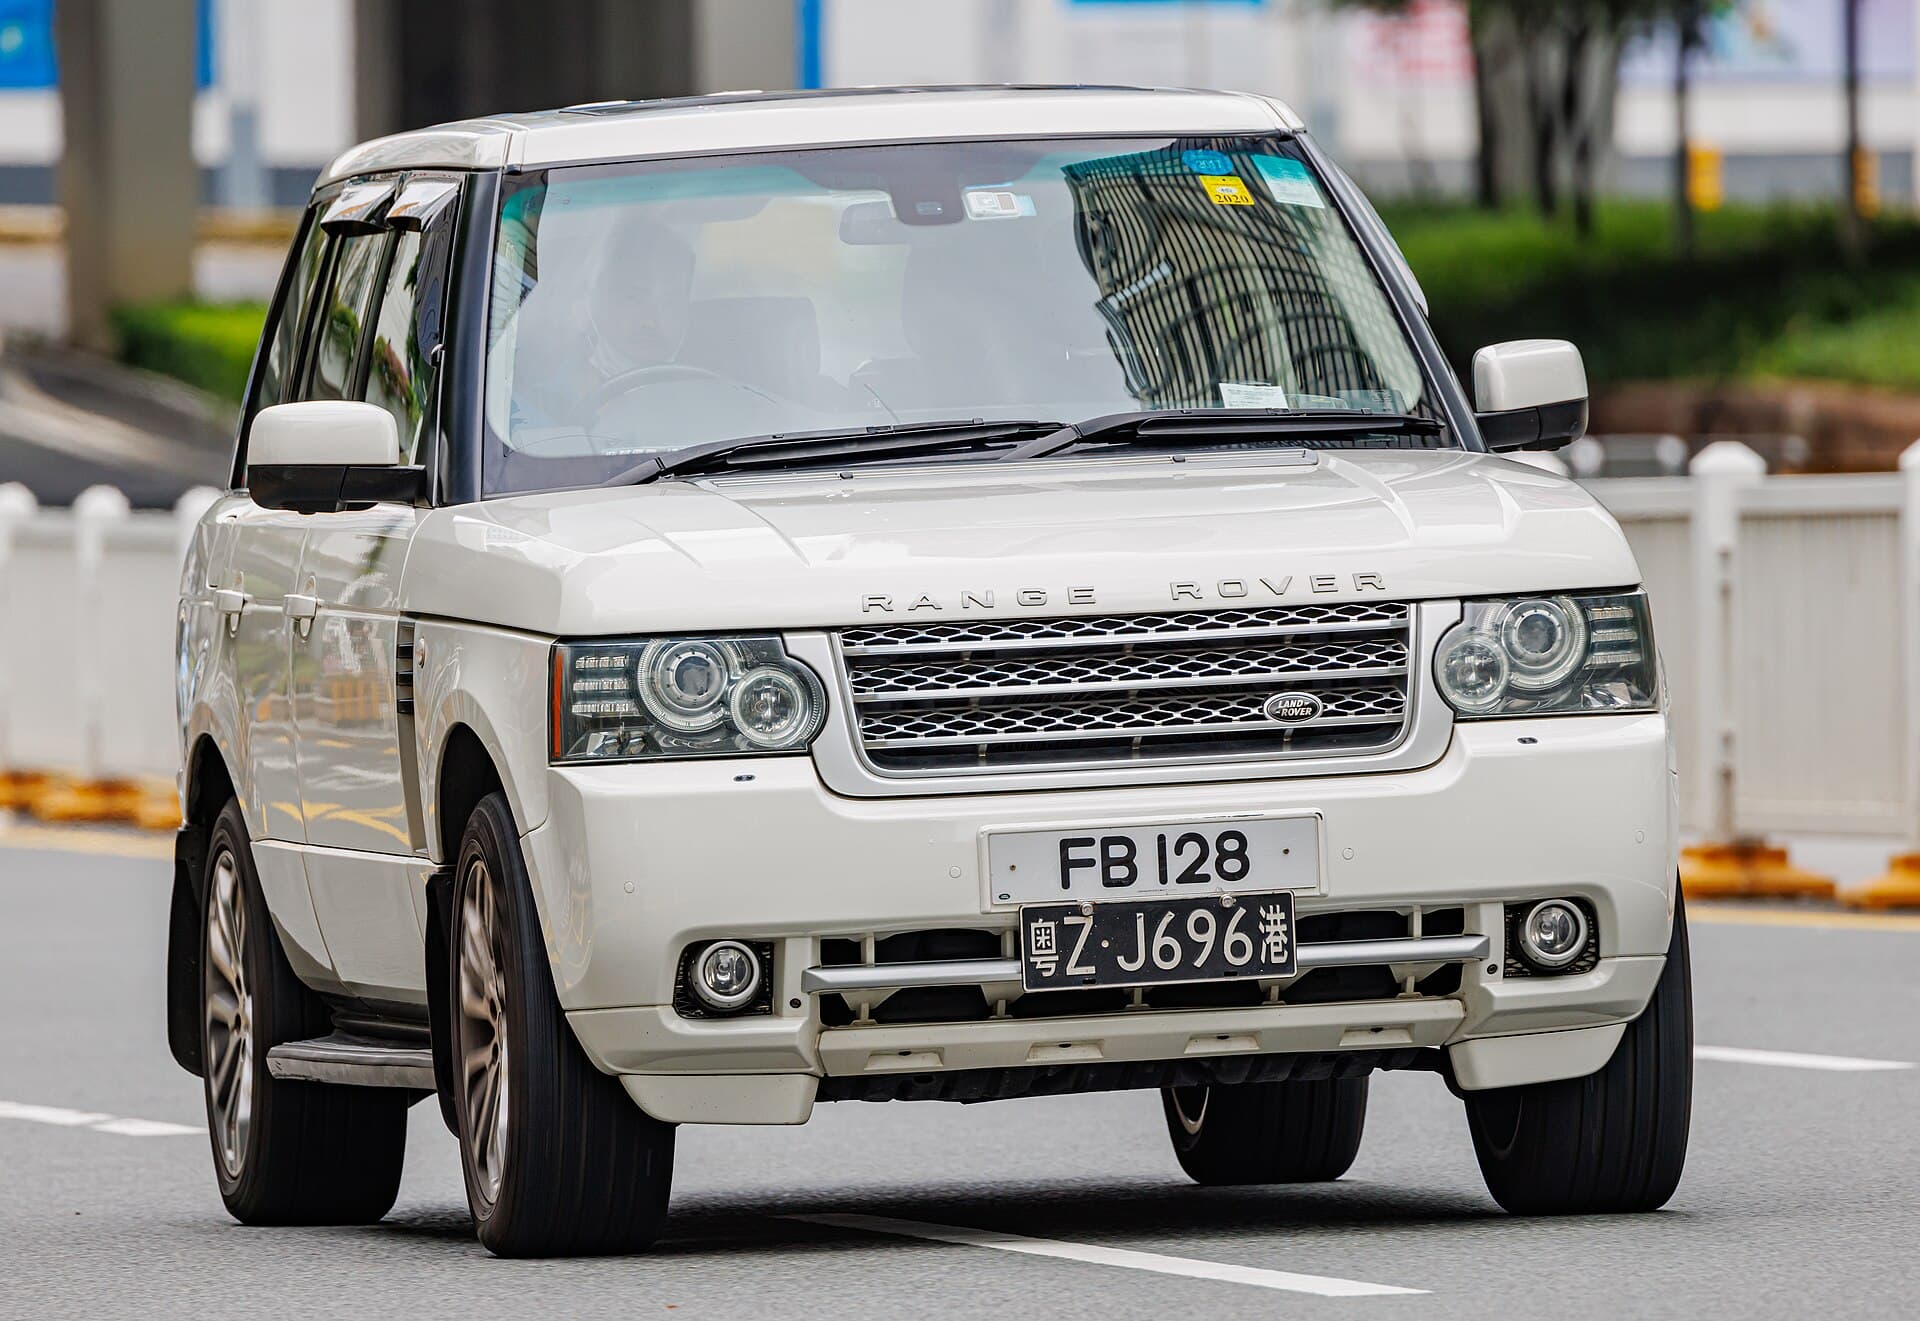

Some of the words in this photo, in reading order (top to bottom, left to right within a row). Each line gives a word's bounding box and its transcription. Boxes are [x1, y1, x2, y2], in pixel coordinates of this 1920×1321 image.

[1215, 194, 1249, 204] 2020
[862, 586, 1097, 612] RANGE
[1169, 571, 1386, 601] ROVER
[1278, 699, 1304, 708] LAND
[1281, 707, 1313, 717] ROVER
[1059, 835, 1138, 890] FB
[1157, 829, 1250, 885] 128
